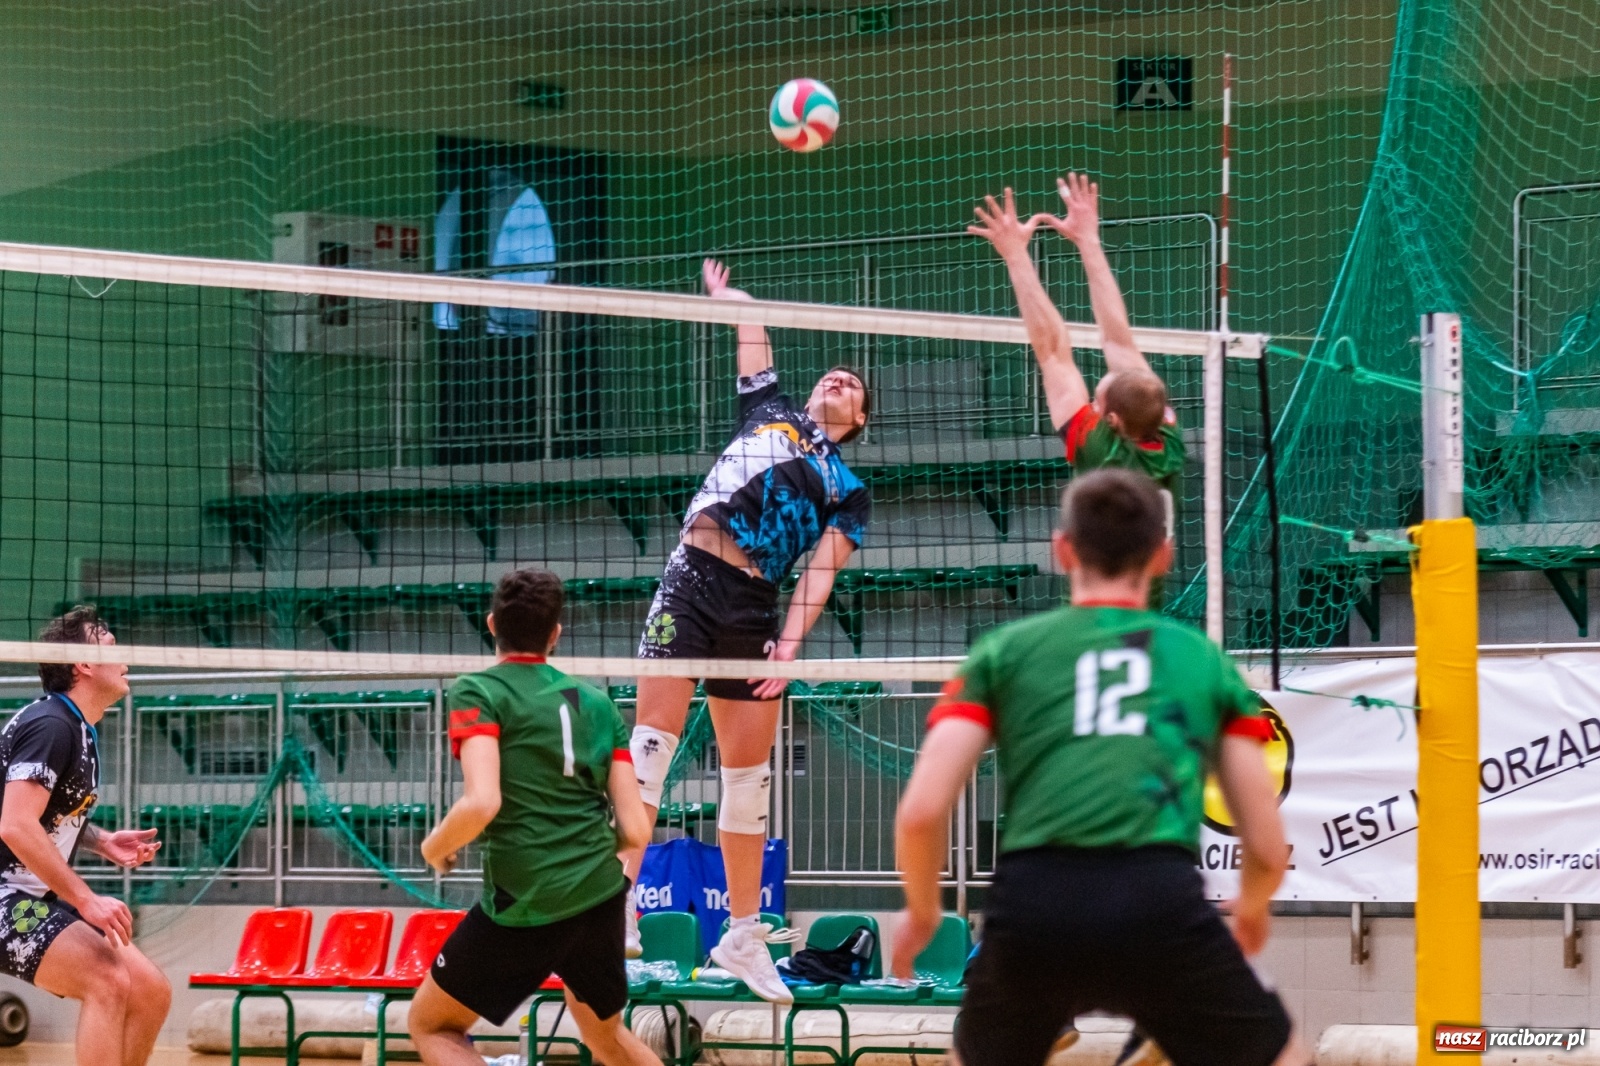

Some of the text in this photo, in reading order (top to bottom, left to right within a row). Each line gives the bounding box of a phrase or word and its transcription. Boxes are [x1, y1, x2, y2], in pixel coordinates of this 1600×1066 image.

[1130, 76, 1178, 105] A
[1074, 648, 1151, 736] 12
[559, 703, 574, 777] 1
[1479, 717, 1600, 793] ORZĄD
[1319, 795, 1399, 858] JEST
[1478, 848, 1600, 870] ww.osir-raci
